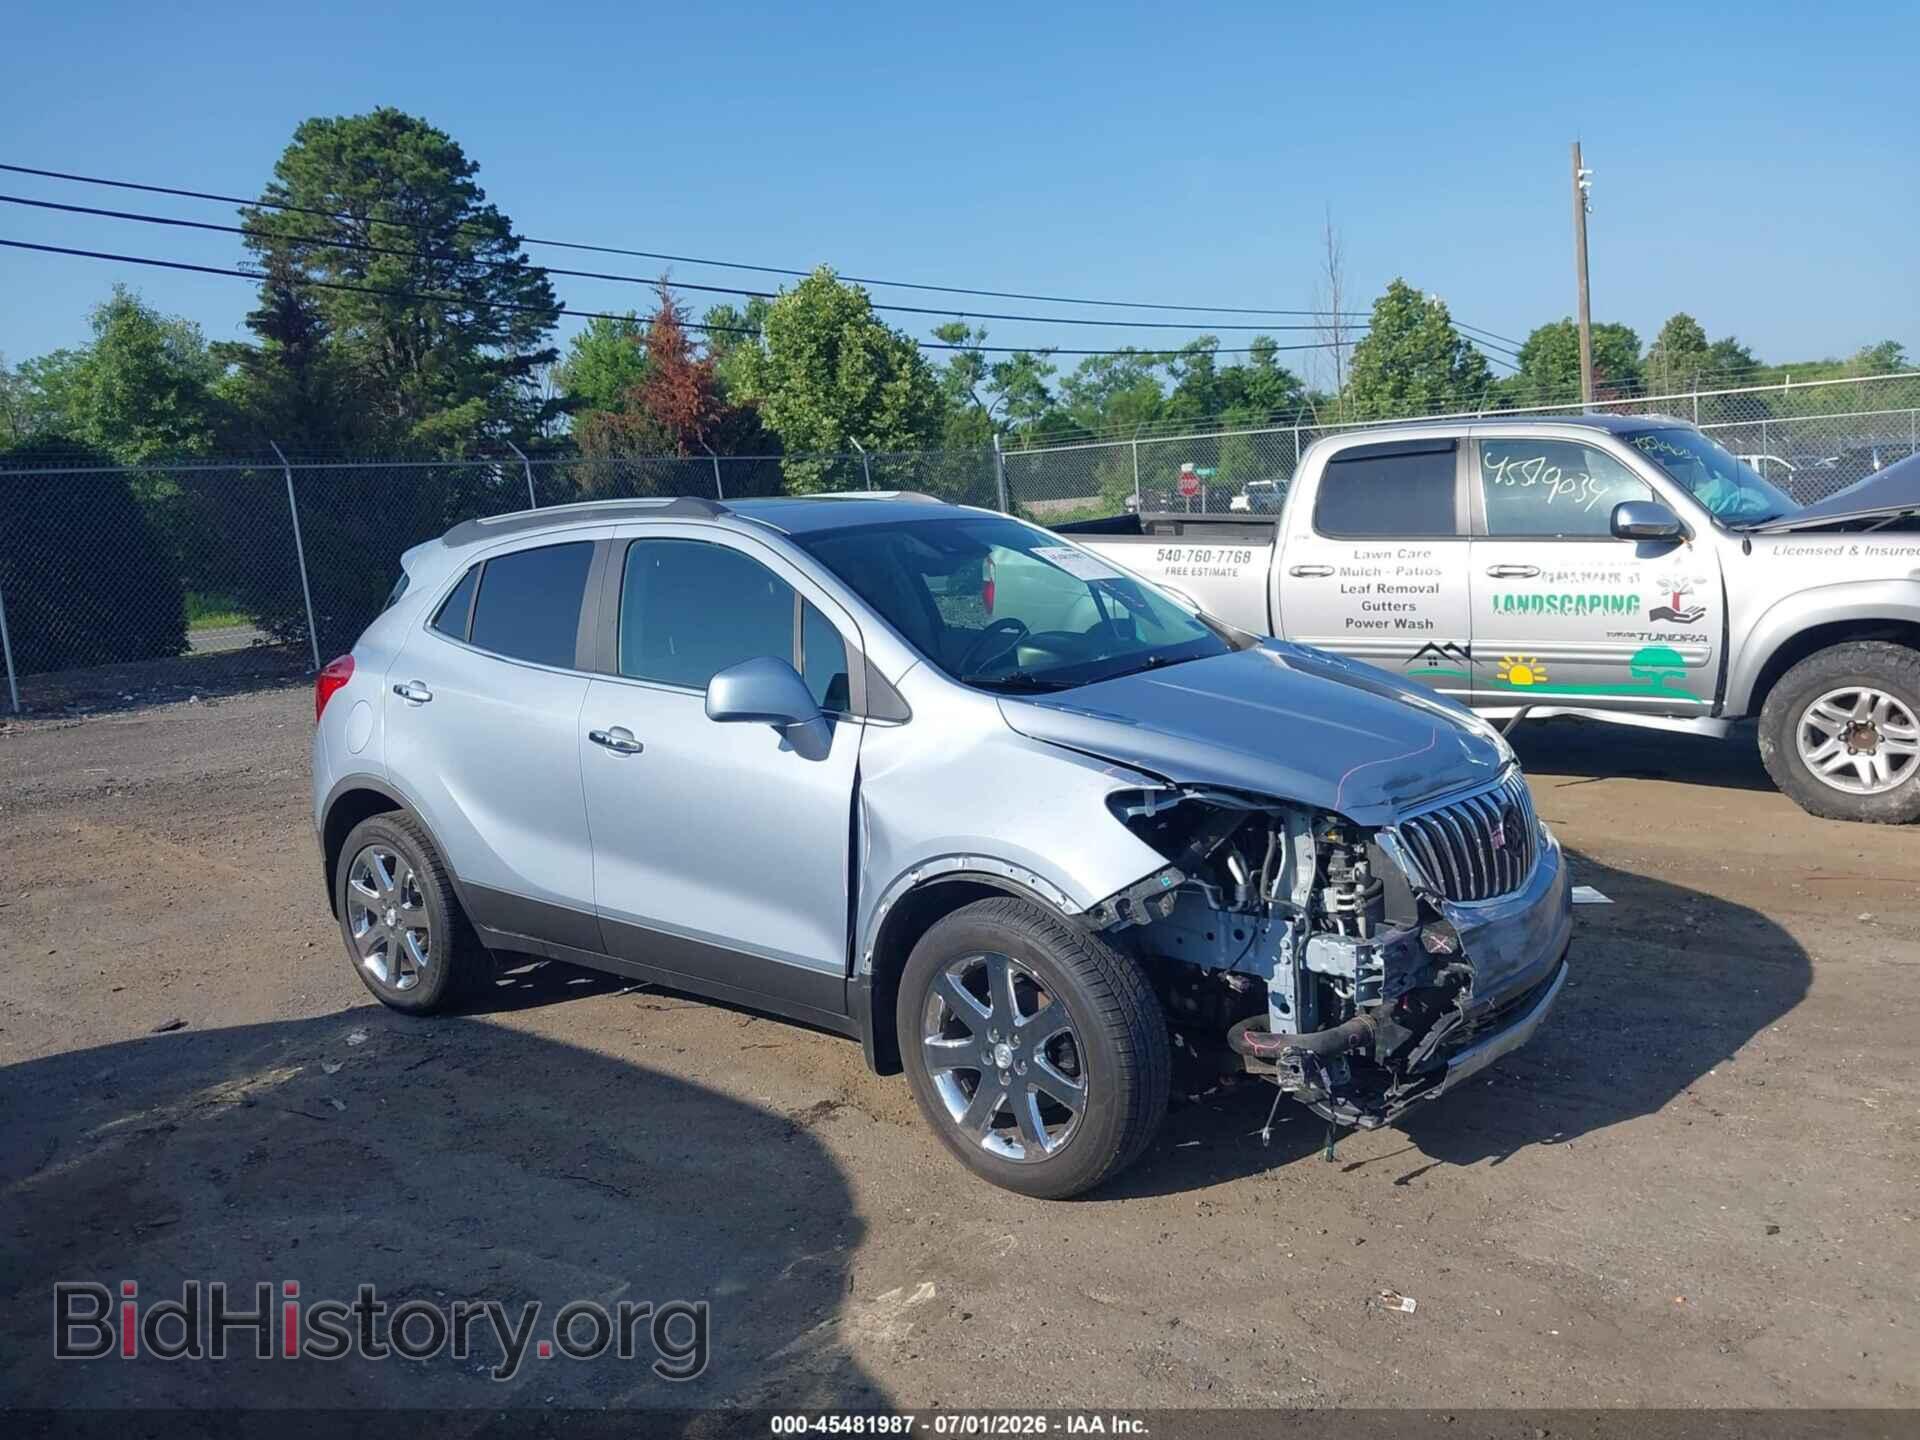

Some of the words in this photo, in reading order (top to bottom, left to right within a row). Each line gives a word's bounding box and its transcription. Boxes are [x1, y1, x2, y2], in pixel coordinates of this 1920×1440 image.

[1179, 479, 1200, 489] STOP
[1156, 548, 1252, 564] 540-760-7768
[1353, 549, 1392, 560] Lawn
[1397, 548, 1432, 560] Care
[1772, 545, 1844, 556] Licensed
[1848, 544, 1859, 556] &
[1164, 566, 1189, 577] FREE
[1191, 567, 1239, 578] ESTIMATE
[1339, 566, 1382, 577] Mulch
[1395, 565, 1443, 577] Patios
[1340, 583, 1371, 595] Leaf
[1376, 583, 1440, 595] Removal
[1361, 600, 1417, 612] Gutters
[1492, 594, 1641, 616] LANDSCAPING
[1345, 617, 1389, 630] Power
[1394, 617, 1434, 630] Wash
[1637, 632, 1708, 643] TUNDRA
